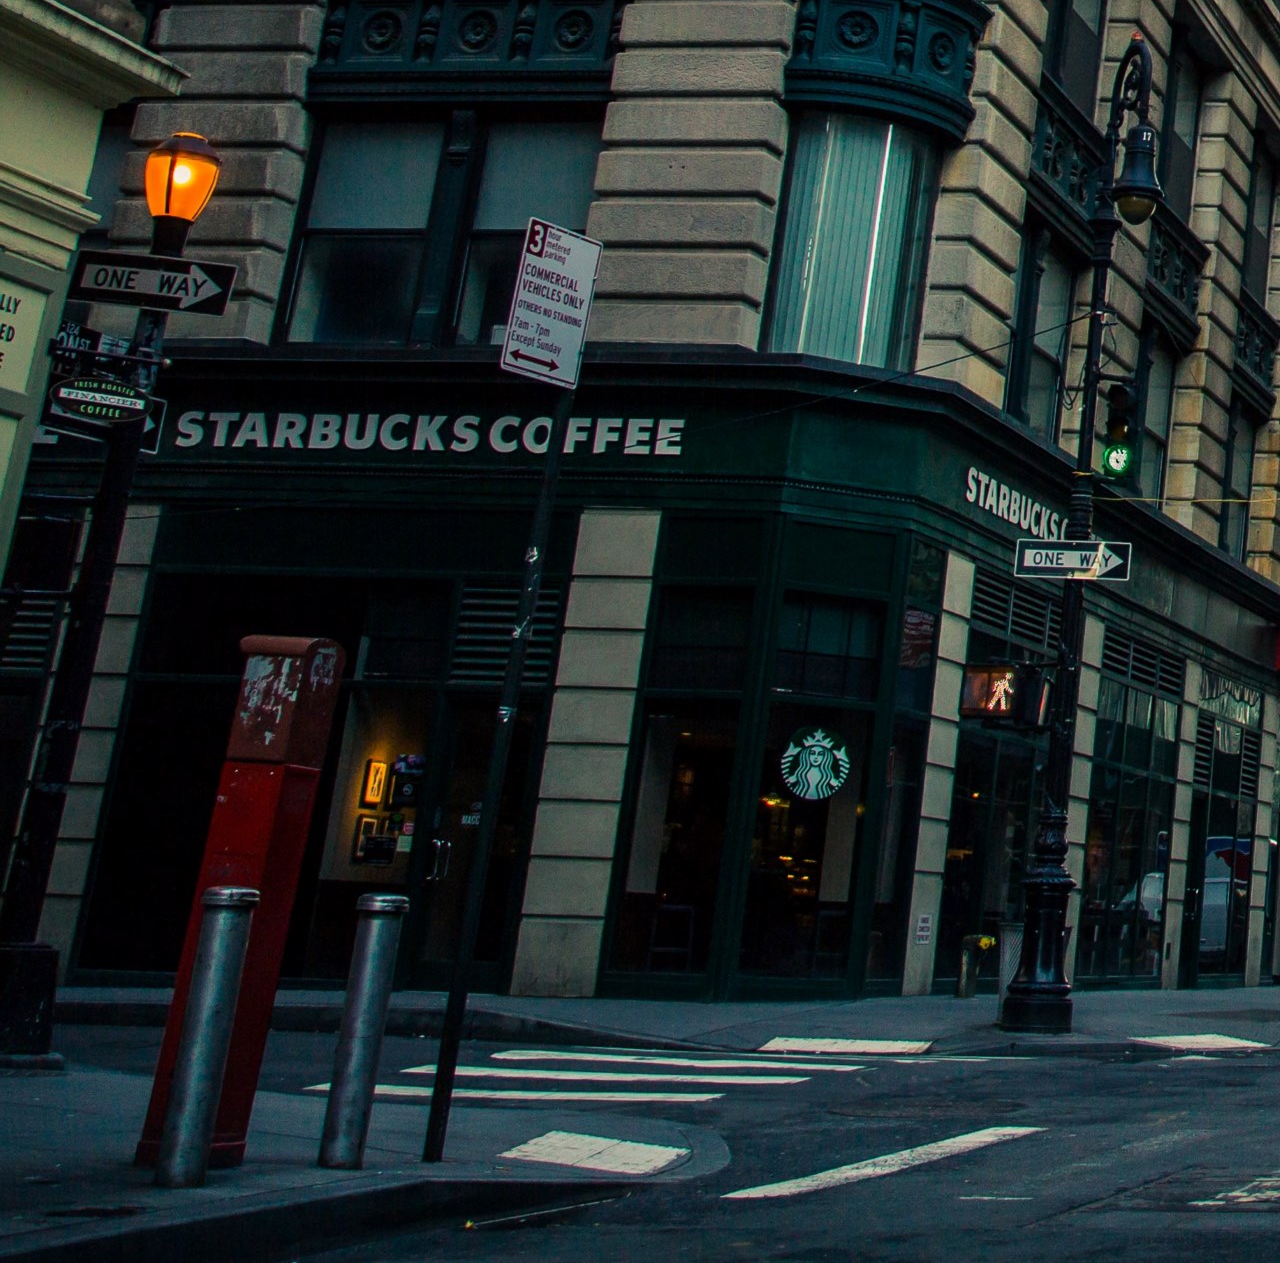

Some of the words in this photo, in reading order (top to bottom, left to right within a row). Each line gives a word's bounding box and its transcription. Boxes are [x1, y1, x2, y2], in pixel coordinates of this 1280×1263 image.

[530, 224, 545, 253] 3
[546, 239, 572, 256] metered
[548, 230, 562, 242] hour
[543, 250, 567, 266] parking
[94, 267, 139, 290] ONE
[159, 273, 208, 297] WAY
[524, 263, 579, 293] COMMERCIAL
[521, 278, 561, 303] VEHICLES
[563, 293, 585, 311] ONLY
[514, 316, 530, 330] 7am
[535, 323, 550, 337] 7pm
[517, 299, 542, 314] OTHERS
[542, 306, 552, 318] NO
[553, 310, 582, 328] STANDING
[511, 331, 535, 348] Except
[536, 338, 562, 357] Sunday
[80, 404, 121, 418] COFFEE
[175, 411, 480, 453] STARBUCKS
[488, 415, 686, 456] COFFEE
[965, 466, 1059, 540] STARBUCKS
[1032, 551, 1065, 566] ONE
[1079, 552, 1114, 568] WAY
